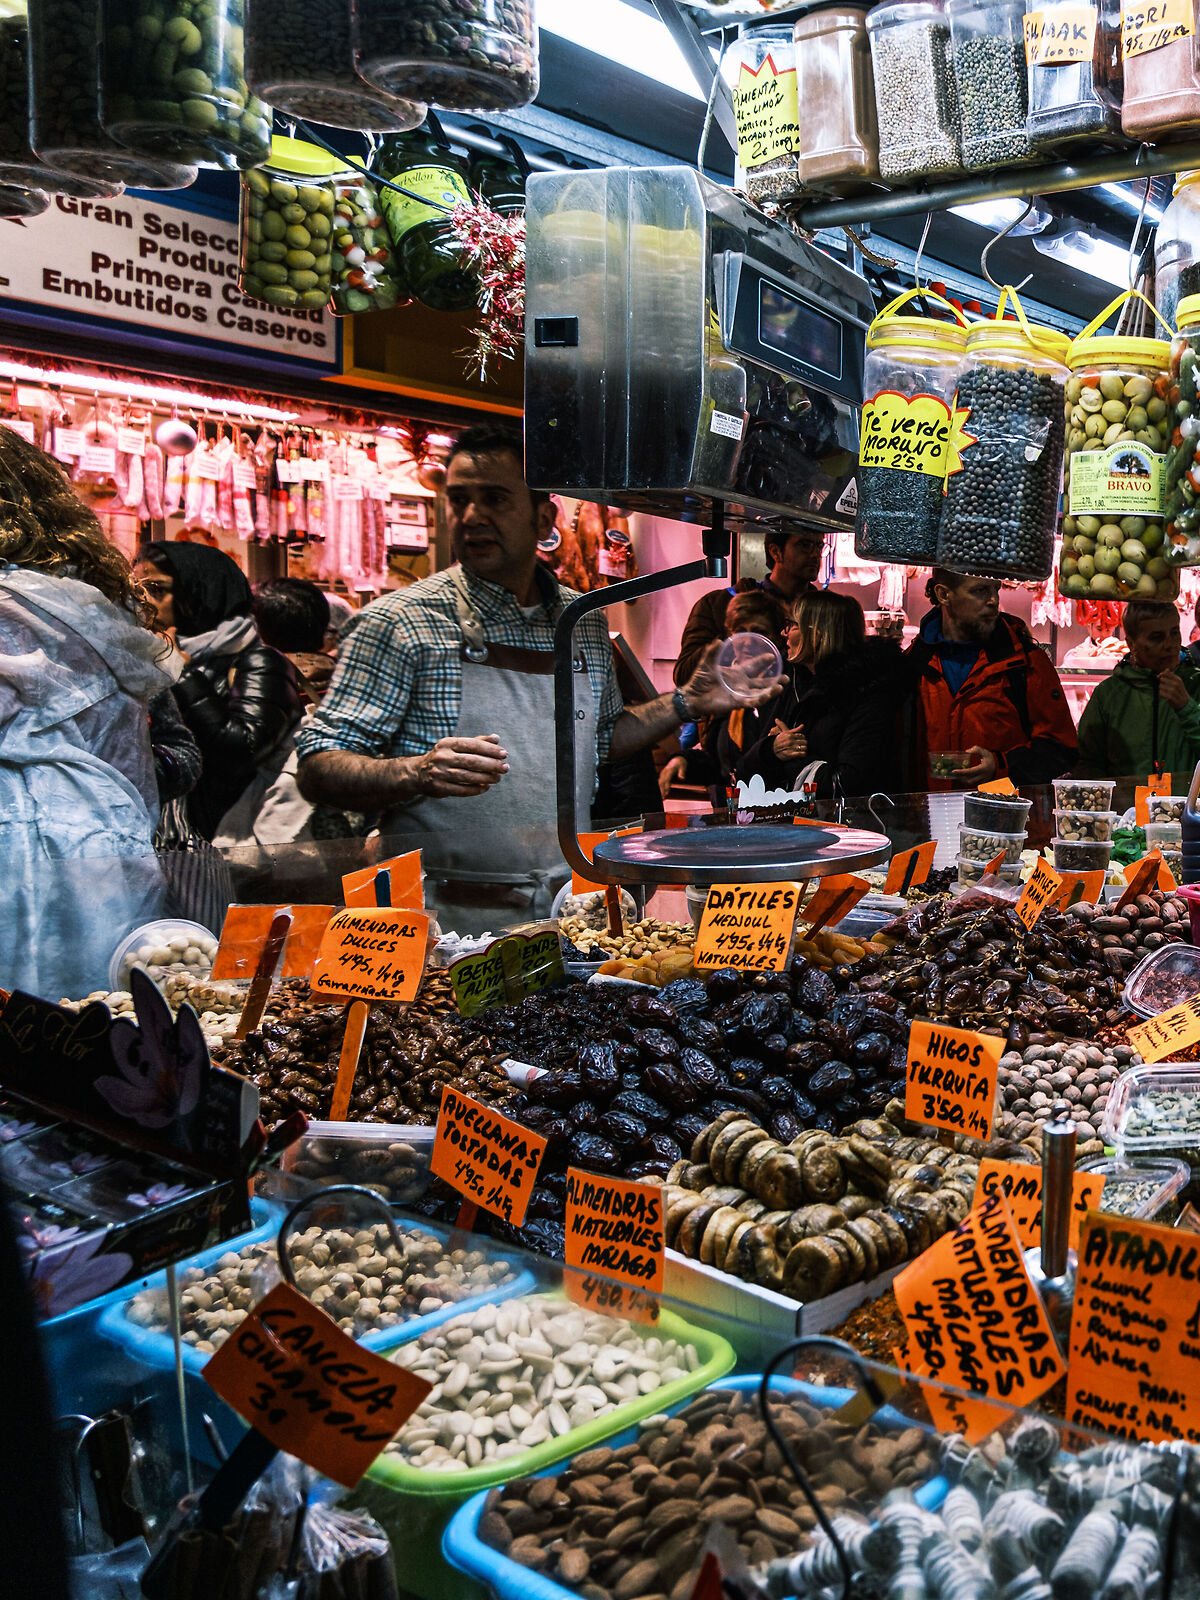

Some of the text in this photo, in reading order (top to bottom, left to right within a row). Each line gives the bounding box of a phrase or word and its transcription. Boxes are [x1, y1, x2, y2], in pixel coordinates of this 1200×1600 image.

[55, 194, 134, 230] Gran
[143, 212, 240, 257] Selecc
[91, 251, 212, 299] Primera
[138, 235, 239, 281] Produc
[42, 267, 327, 348] Embutidos Caseros
[866, 410, 950, 443] Té verde
[863, 434, 943, 458] MORUNO
[1107, 480, 1152, 492] BRAVO
[707, 886, 795, 910] DÁTILES
[330, 913, 418, 938] ALMENDRAS
[340, 933, 398, 953] DULCES
[697, 951, 778, 971] NATURALES
[926, 1031, 984, 1067] HIGOS
[443, 1094, 541, 1169] AVELLANAS
[443, 1120, 523, 1188] TOSTADAS
[566, 1175, 660, 1226] ALMENDRAS
[571, 1213, 663, 1253] NATURALES
[978, 1193, 1057, 1379] ALMENDRAS
[1090, 1272, 1153, 1304] Laurel
[949, 1218, 1025, 1397] NATURALES
[1087, 1315, 1161, 1352] Romero
[260, 1308, 398, 1415] CANELA
